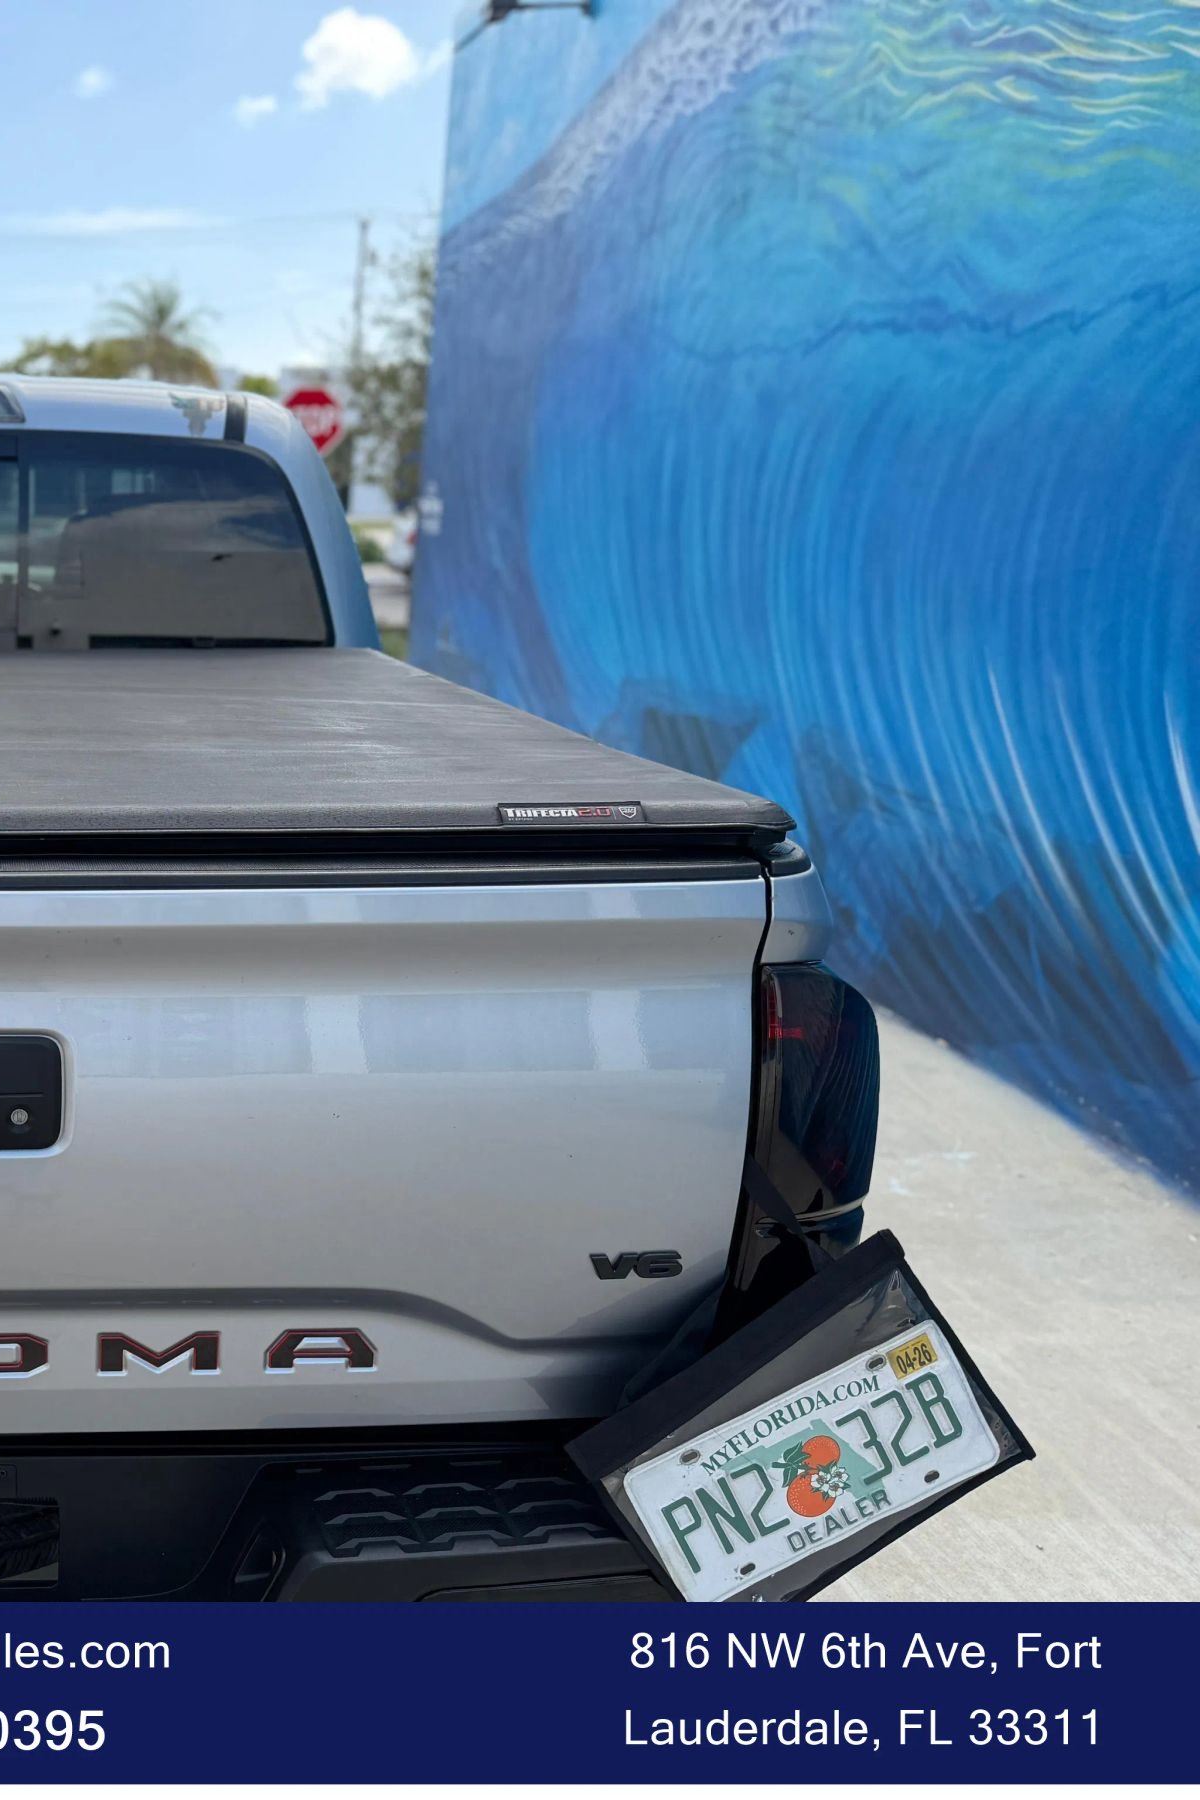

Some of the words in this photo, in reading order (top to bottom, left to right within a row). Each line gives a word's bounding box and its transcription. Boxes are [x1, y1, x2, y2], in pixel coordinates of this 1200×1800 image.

[589, 1250, 683, 1280] V6
[896, 1343, 933, 1374] 04-26
[700, 1374, 881, 1477] MYFLORIDA.COM
[661, 1462, 790, 1574] PN2
[835, 1371, 963, 1485] 32B
[786, 1488, 892, 1552] DEALER
